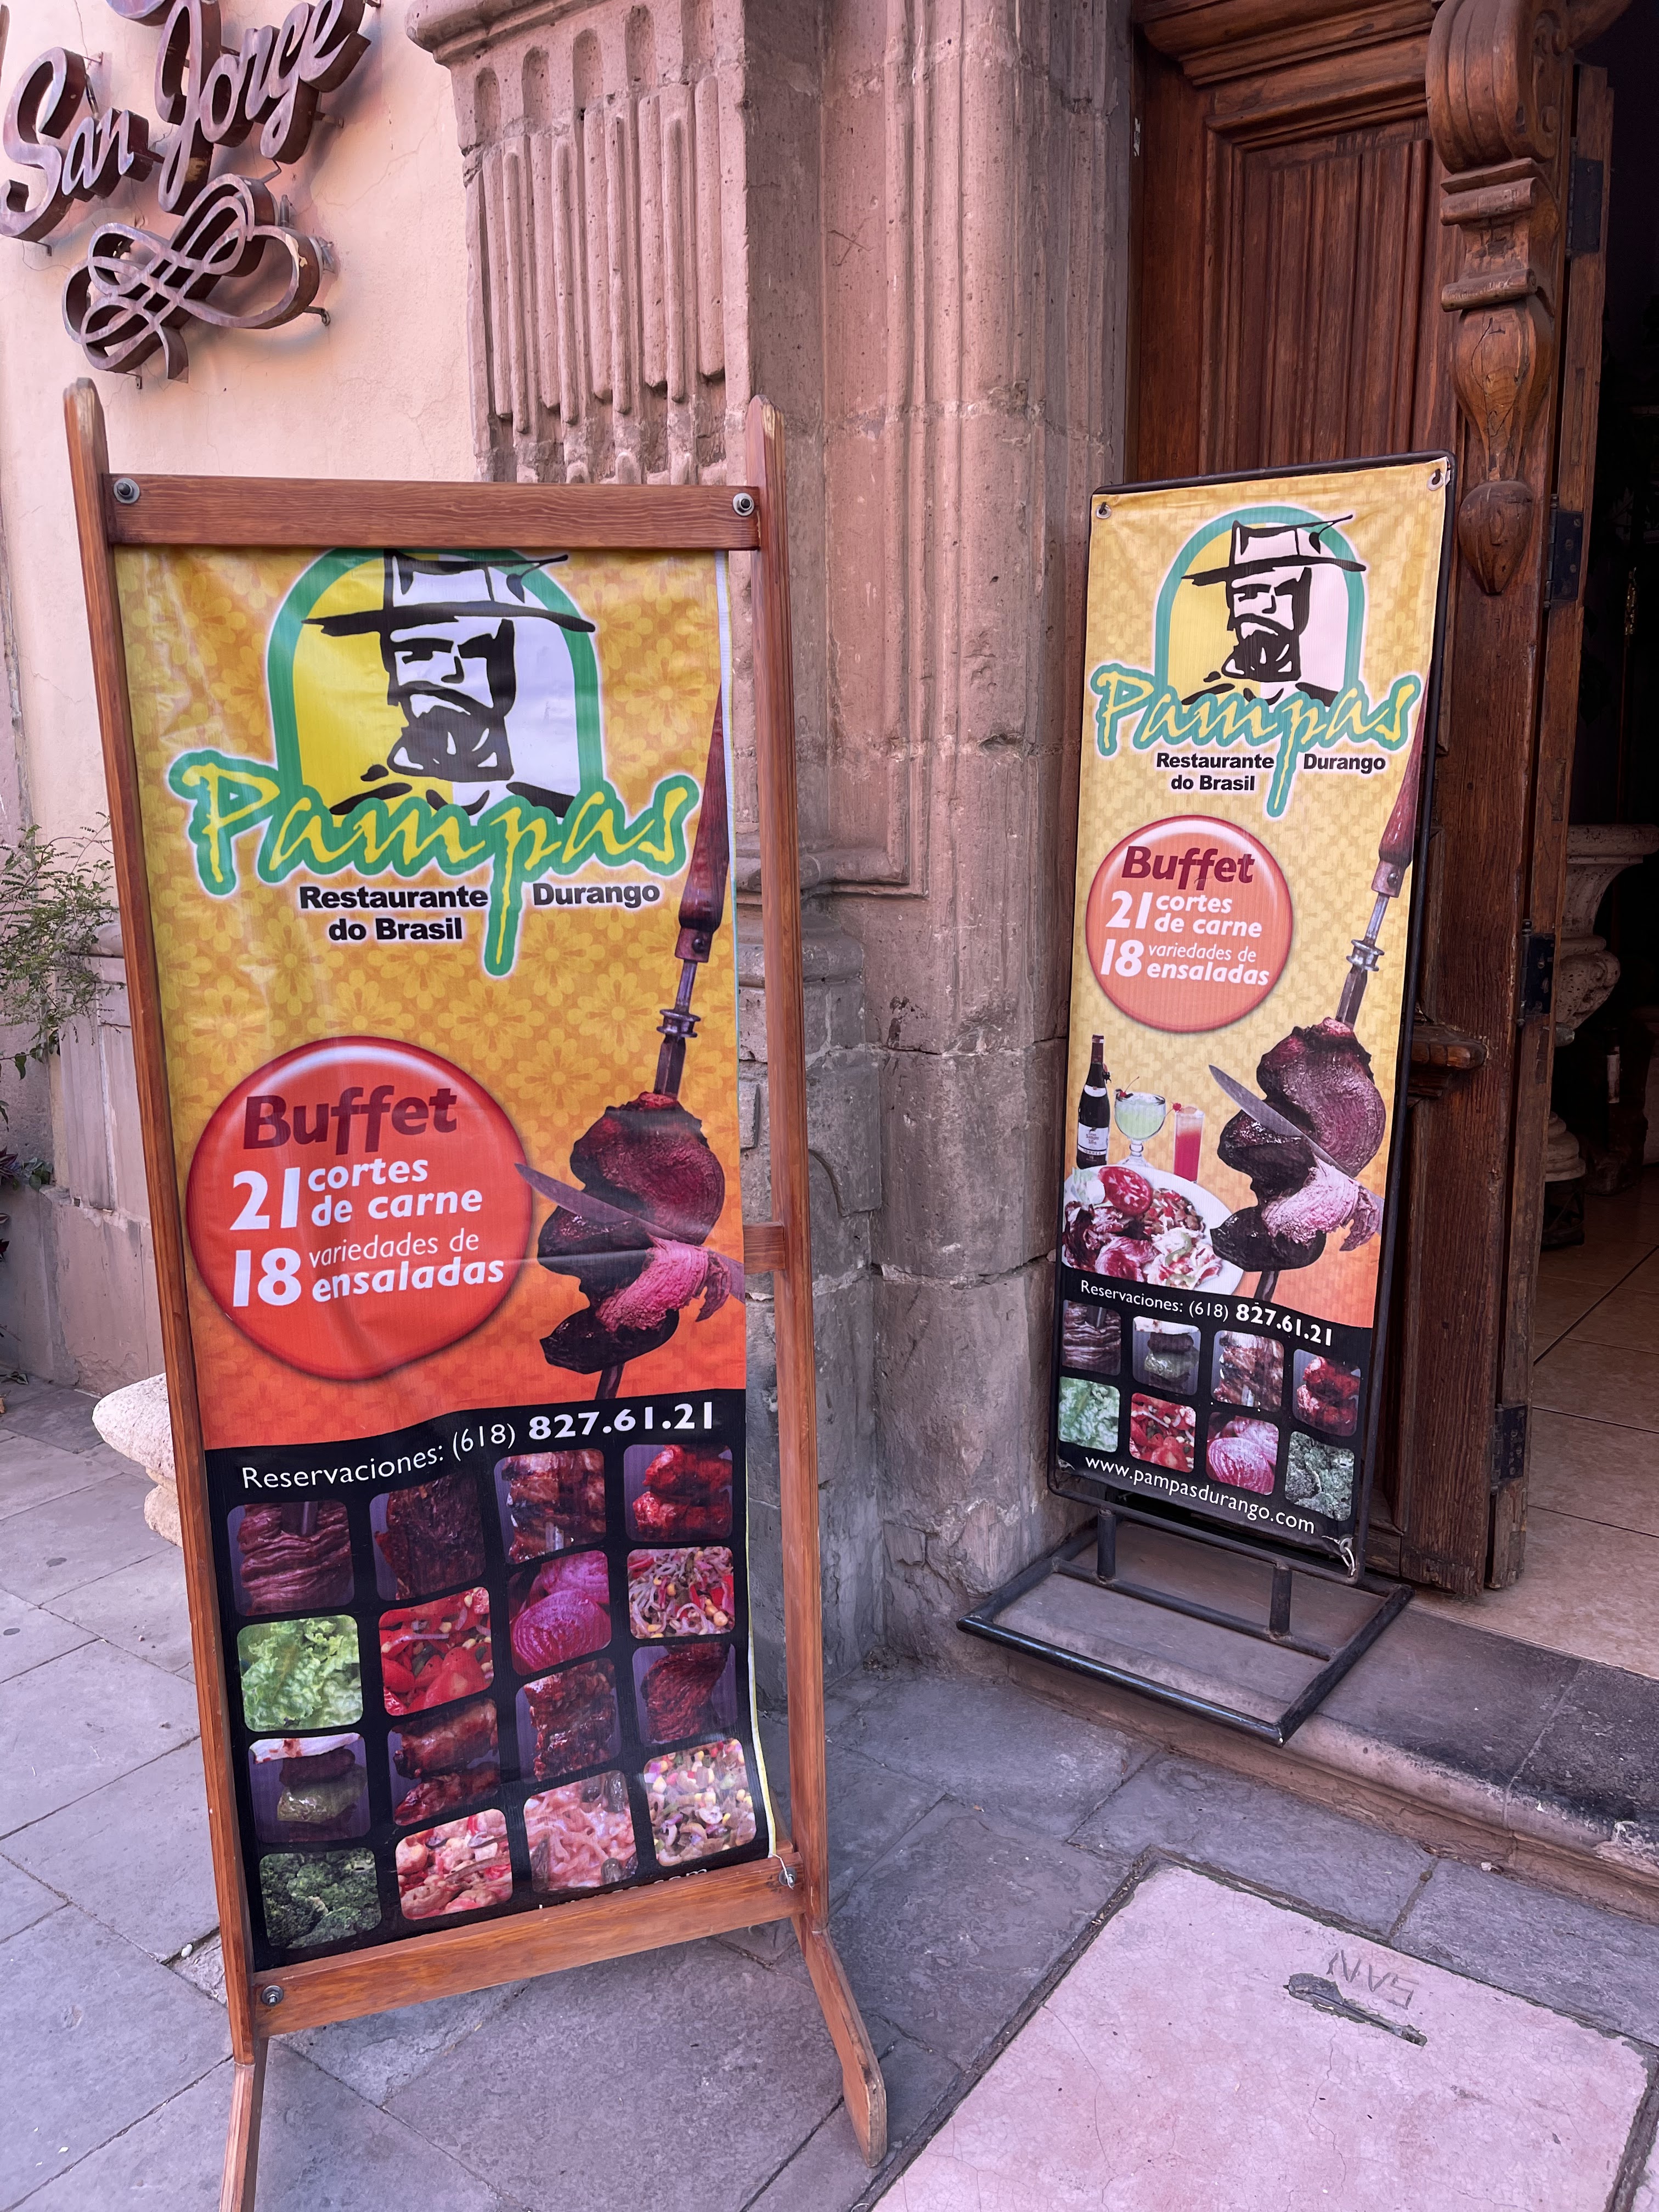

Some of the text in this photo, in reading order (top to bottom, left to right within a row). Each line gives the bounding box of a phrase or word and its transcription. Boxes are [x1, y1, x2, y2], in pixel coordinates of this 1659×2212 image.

[114, 0, 362, 213] Jorge
[0, 47, 133, 239] San
[1091, 664, 1421, 817] Pampas
[1156, 752, 1386, 774] Restaurante Durango
[1171, 775, 1255, 791] do Brasil
[169, 749, 700, 975] Pampas
[1121, 846, 1255, 890] Buffet
[300, 882, 660, 910] Restaurante Durango
[1106, 890, 1233, 929] 21 cortes
[329, 917, 462, 942] do Brasil
[1154, 913, 1262, 938] de carne
[1101, 939, 1256, 977] 18 variedades de
[1147, 962, 1269, 986] ensaladas
[244, 1085, 457, 1155] Buffet
[229, 1158, 428, 1231] 21 cortes
[311, 1189, 482, 1227] de carne
[233, 1228, 478, 1307] 18 variedades de
[312, 1257, 504, 1302] ensaladas
[1081, 1279, 1332, 1346] Reservaciones: (618) 827.61.21
[242, 1401, 713, 1489] Reservaciones: (618) 827.61.21
[1085, 1457, 1315, 1534] www.pampasdurango.com
